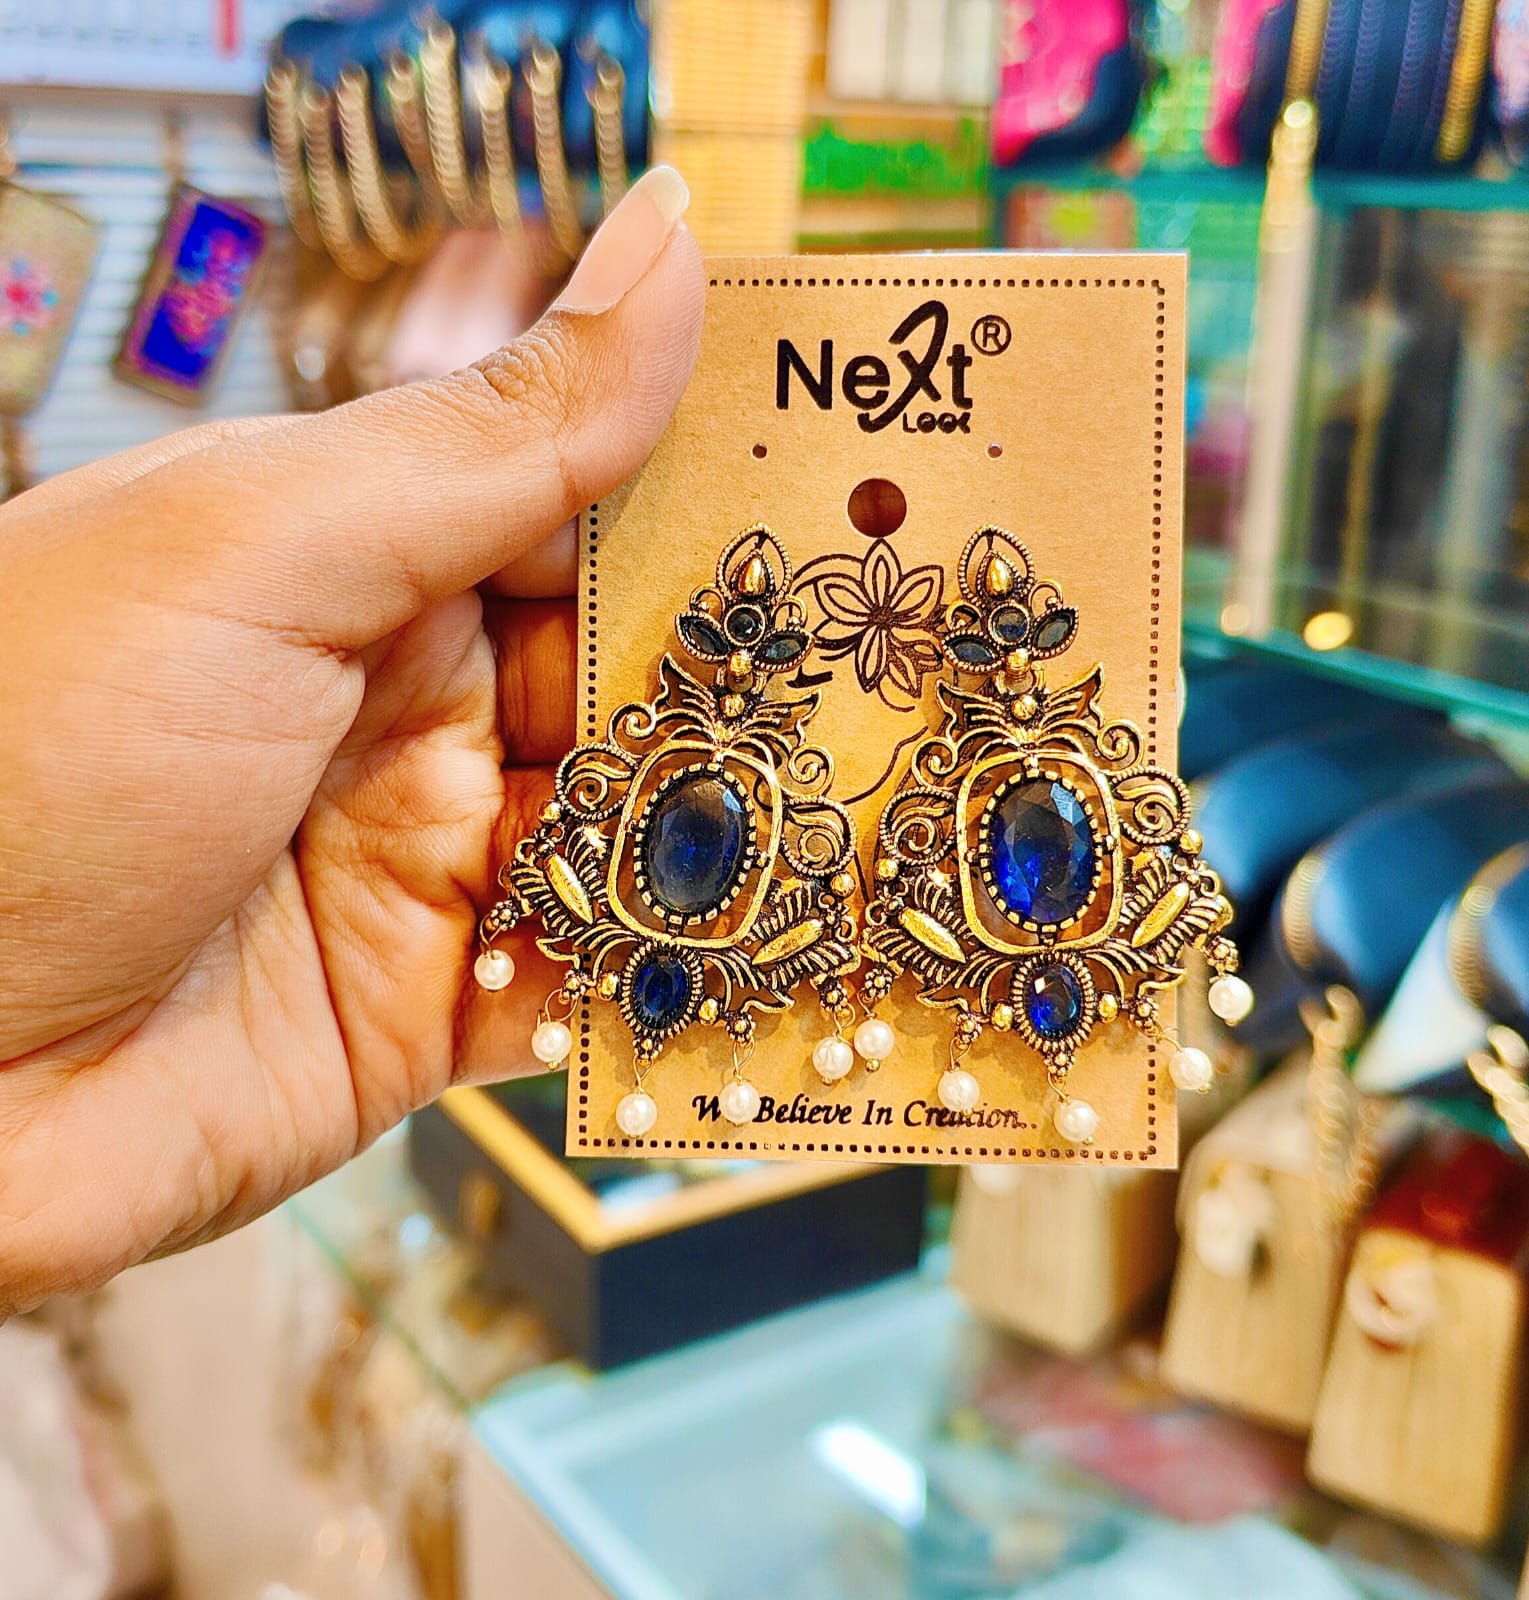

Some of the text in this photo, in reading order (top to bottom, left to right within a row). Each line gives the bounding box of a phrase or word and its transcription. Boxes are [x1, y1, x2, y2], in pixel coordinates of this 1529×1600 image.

[902, 412, 971, 433] LOOK
[752, 1093, 852, 1125] Believe
[862, 1100, 894, 1125] In
